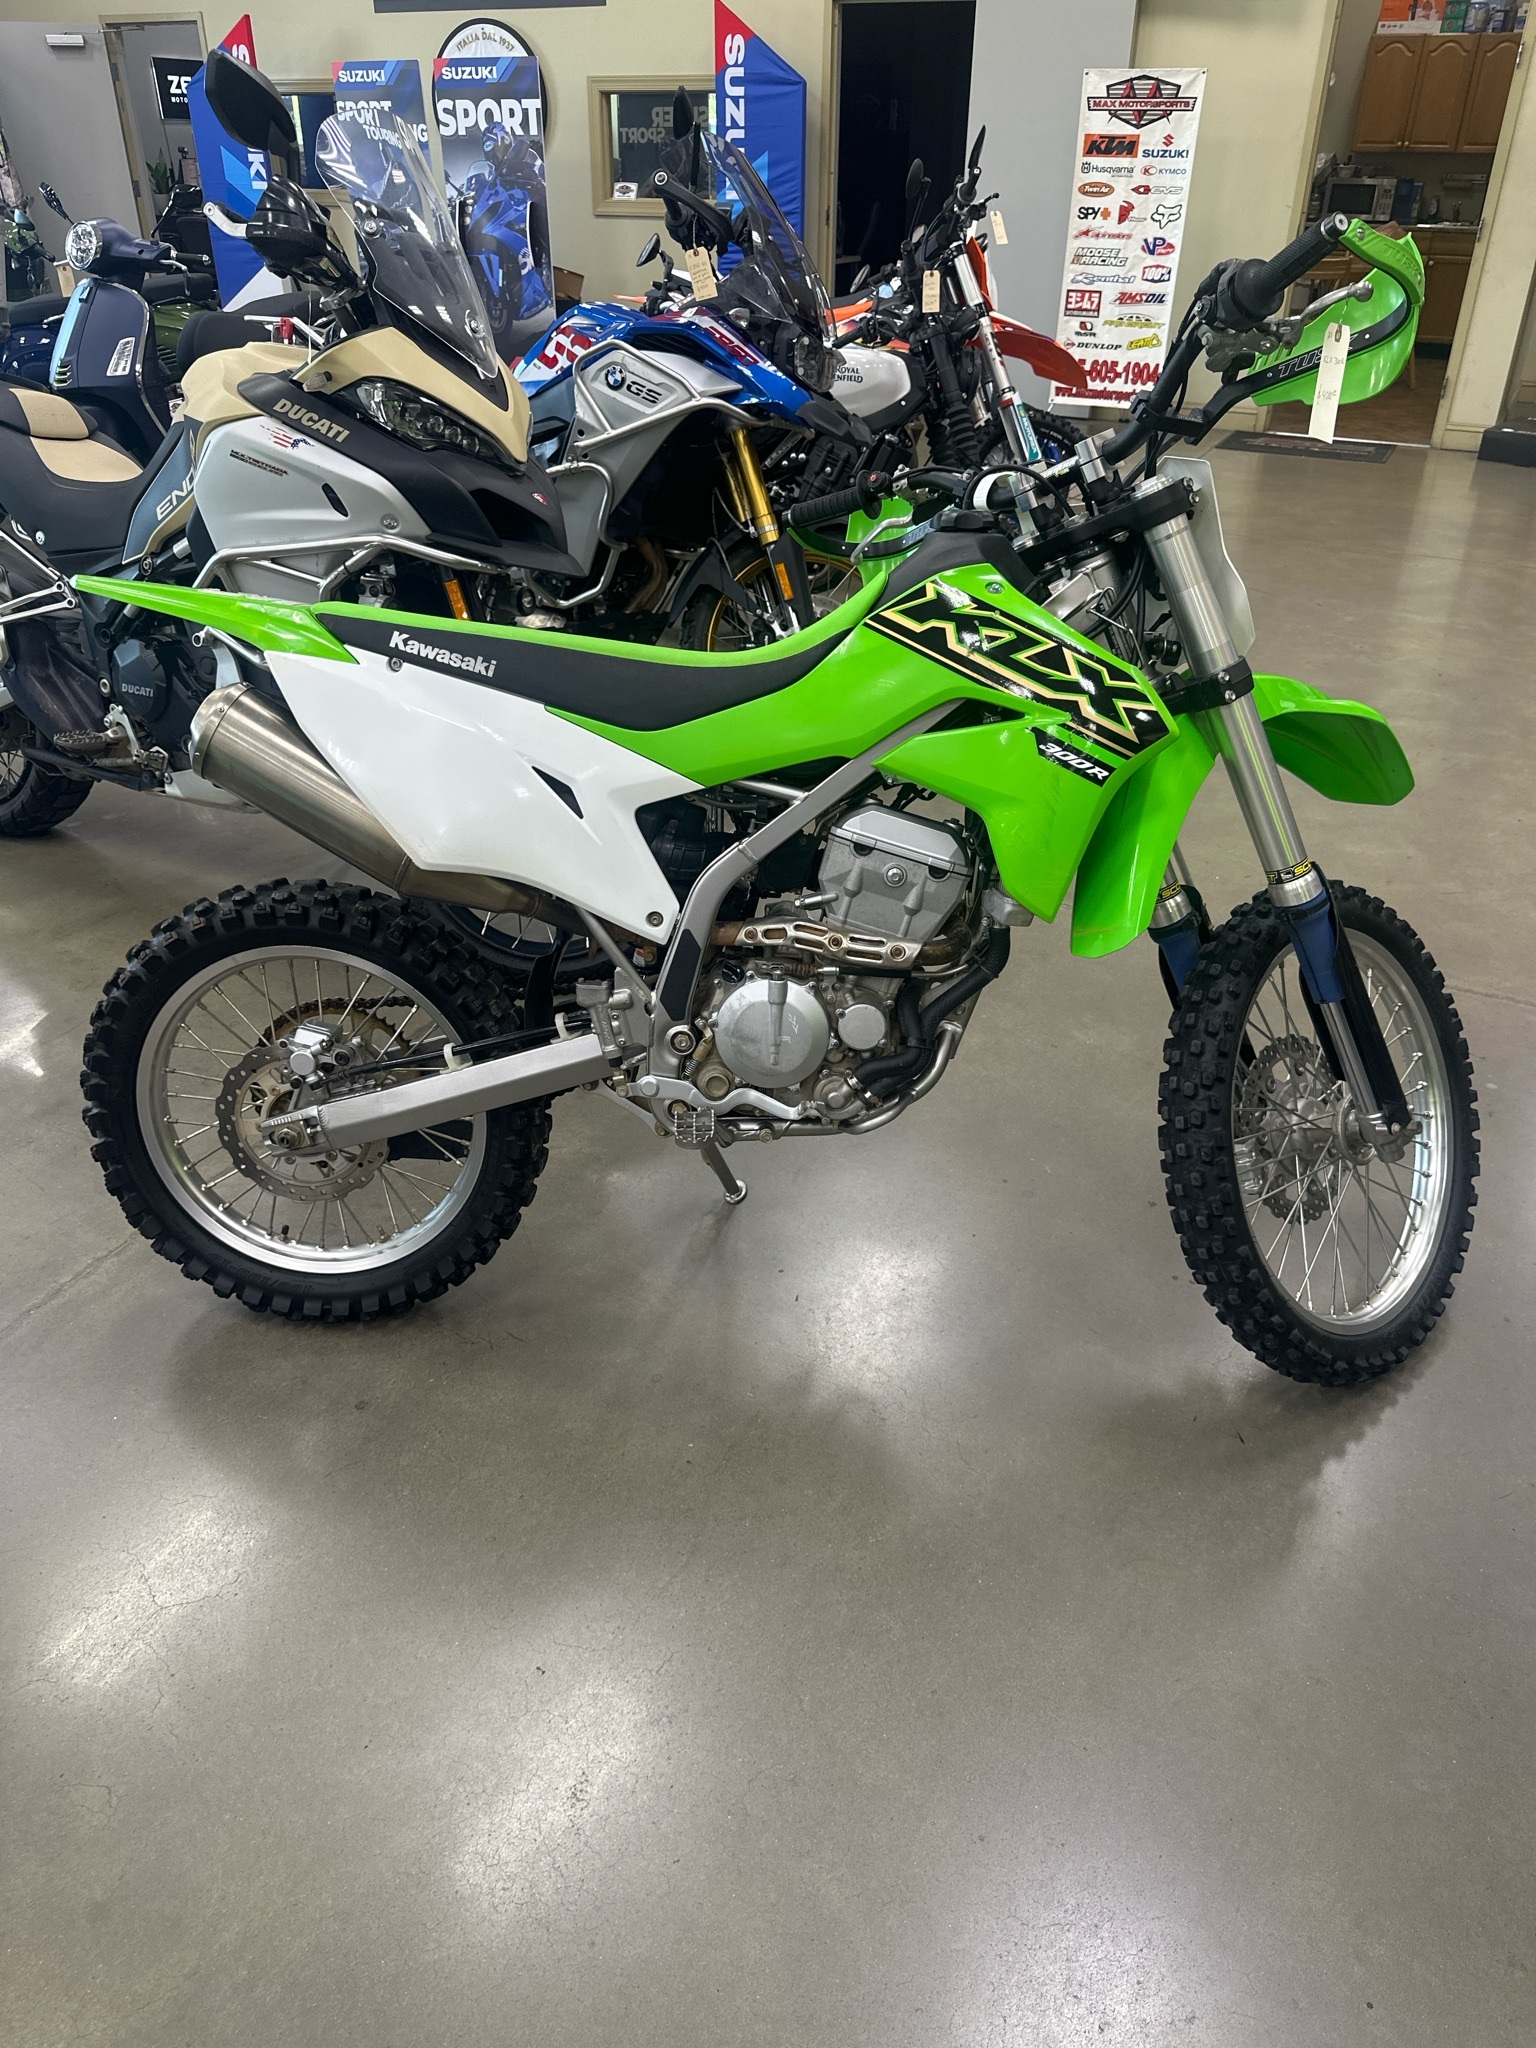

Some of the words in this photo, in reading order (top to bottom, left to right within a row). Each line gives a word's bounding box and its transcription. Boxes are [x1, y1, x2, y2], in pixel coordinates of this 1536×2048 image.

[456, 32, 480, 51] ITALIA
[481, 31, 497, 42] DAL
[498, 36, 515, 52] 1937
[338, 69, 386, 83] SUZUKI
[441, 66, 497, 80] SUZUKI
[1092, 100, 1117, 108] MAX
[1118, 100, 1190, 108] MOTORSPORTS
[436, 99, 541, 136] SPORT
[1085, 136, 1137, 156] KTM
[1142, 149, 1189, 158] SUZUKI
[1091, 165, 1134, 174] Husqvarna
[1083, 185, 1099, 193] Twin
[1077, 206, 1100, 220] SPY
[1075, 247, 1121, 257] MOOSE
[1143, 237, 1166, 256] VP
[1078, 257, 1127, 266] RACING
[1071, 272, 1136, 285] Renthal
[1142, 266, 1171, 281] 100%
[1067, 292, 1100, 309] ヨシムラ
[1114, 292, 1166, 304] AMSOIL
[1076, 342, 1122, 350] DUNLOP
[1078, 358, 1160, 385] -605-1904
[626, 381, 662, 404] GS
[273, 399, 350, 443] DUCATI
[388, 630, 497, 678] Kawasaki
[879, 582, 1156, 744] KLX
[121, 683, 154, 697] DUCATI
[1039, 742, 1111, 781] 300R
